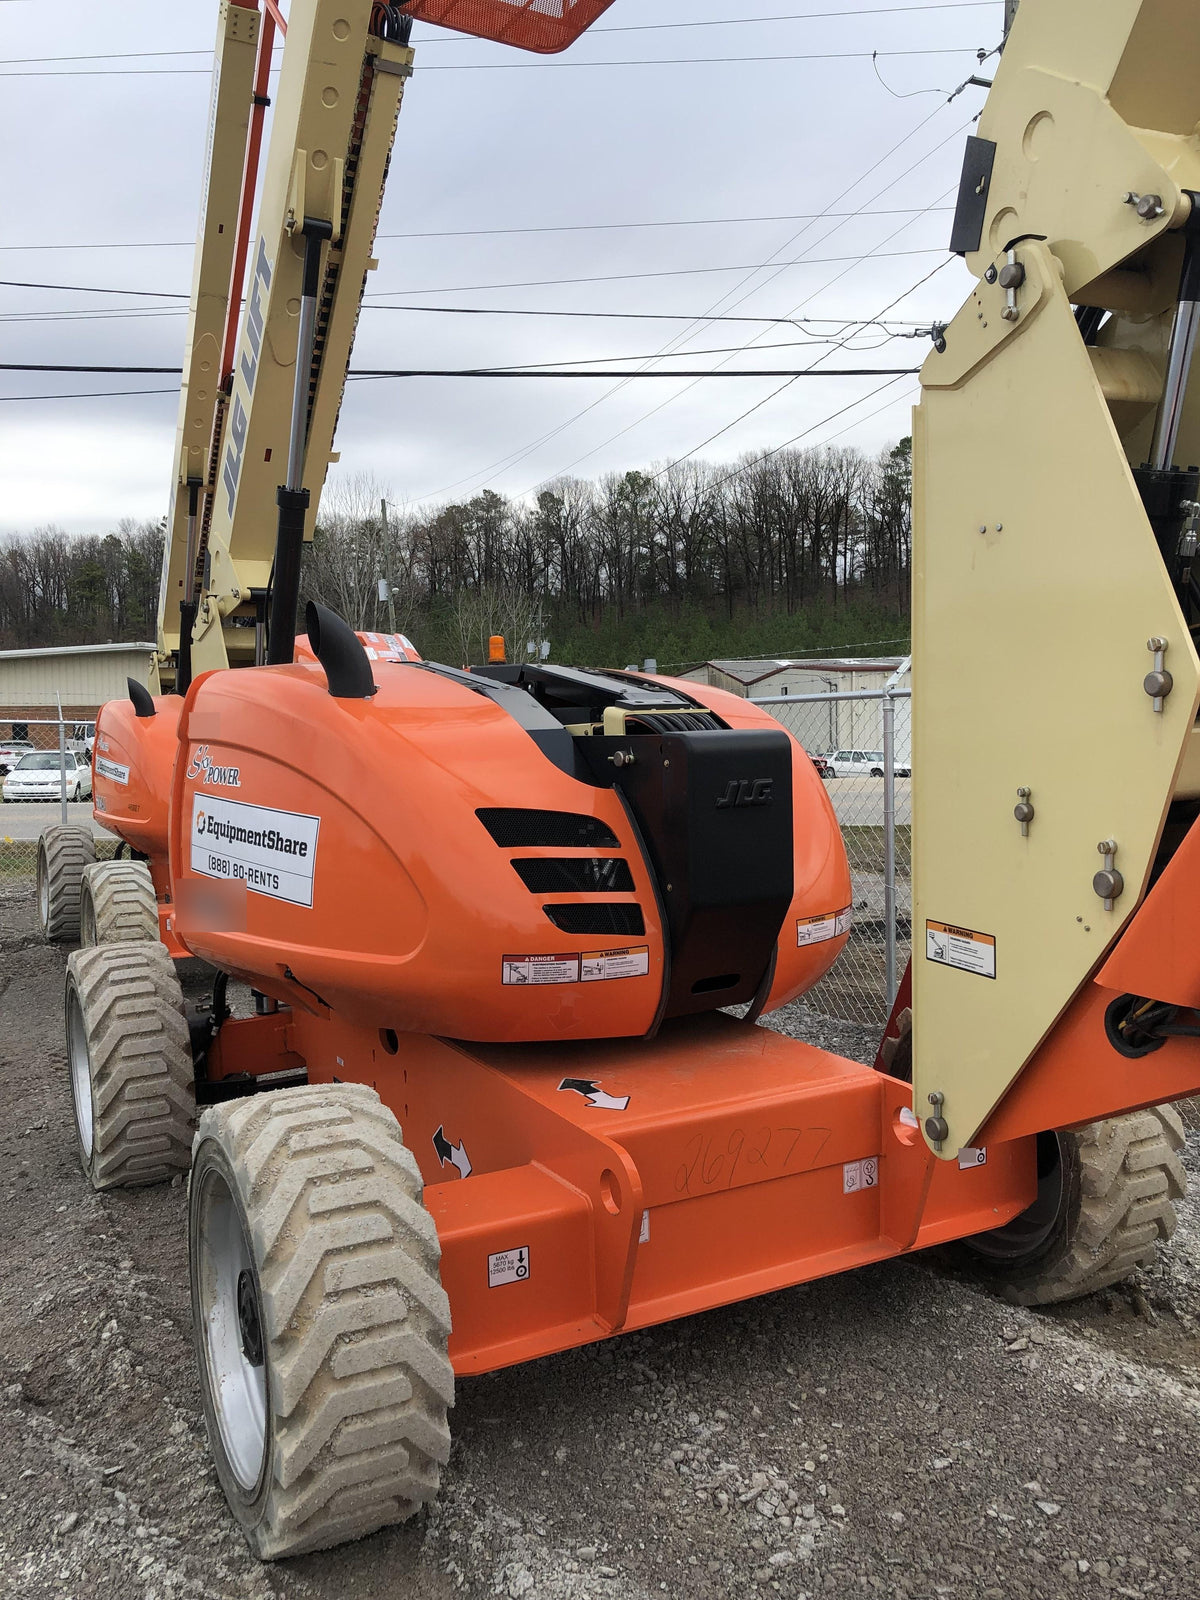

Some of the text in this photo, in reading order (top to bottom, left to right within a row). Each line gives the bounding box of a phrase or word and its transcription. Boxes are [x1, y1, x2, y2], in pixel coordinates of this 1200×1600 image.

[223, 235, 272, 519] JLG LIFT
[206, 766, 240, 786] POWER
[715, 778, 773, 808] JLG
[207, 815, 308, 857] EquipmentShare
[208, 854, 279, 890] (888) 80-RENTS
[948, 926, 974, 940] WARNING
[605, 949, 630, 957] WARNING
[674, 1127, 832, 1194] 269277
